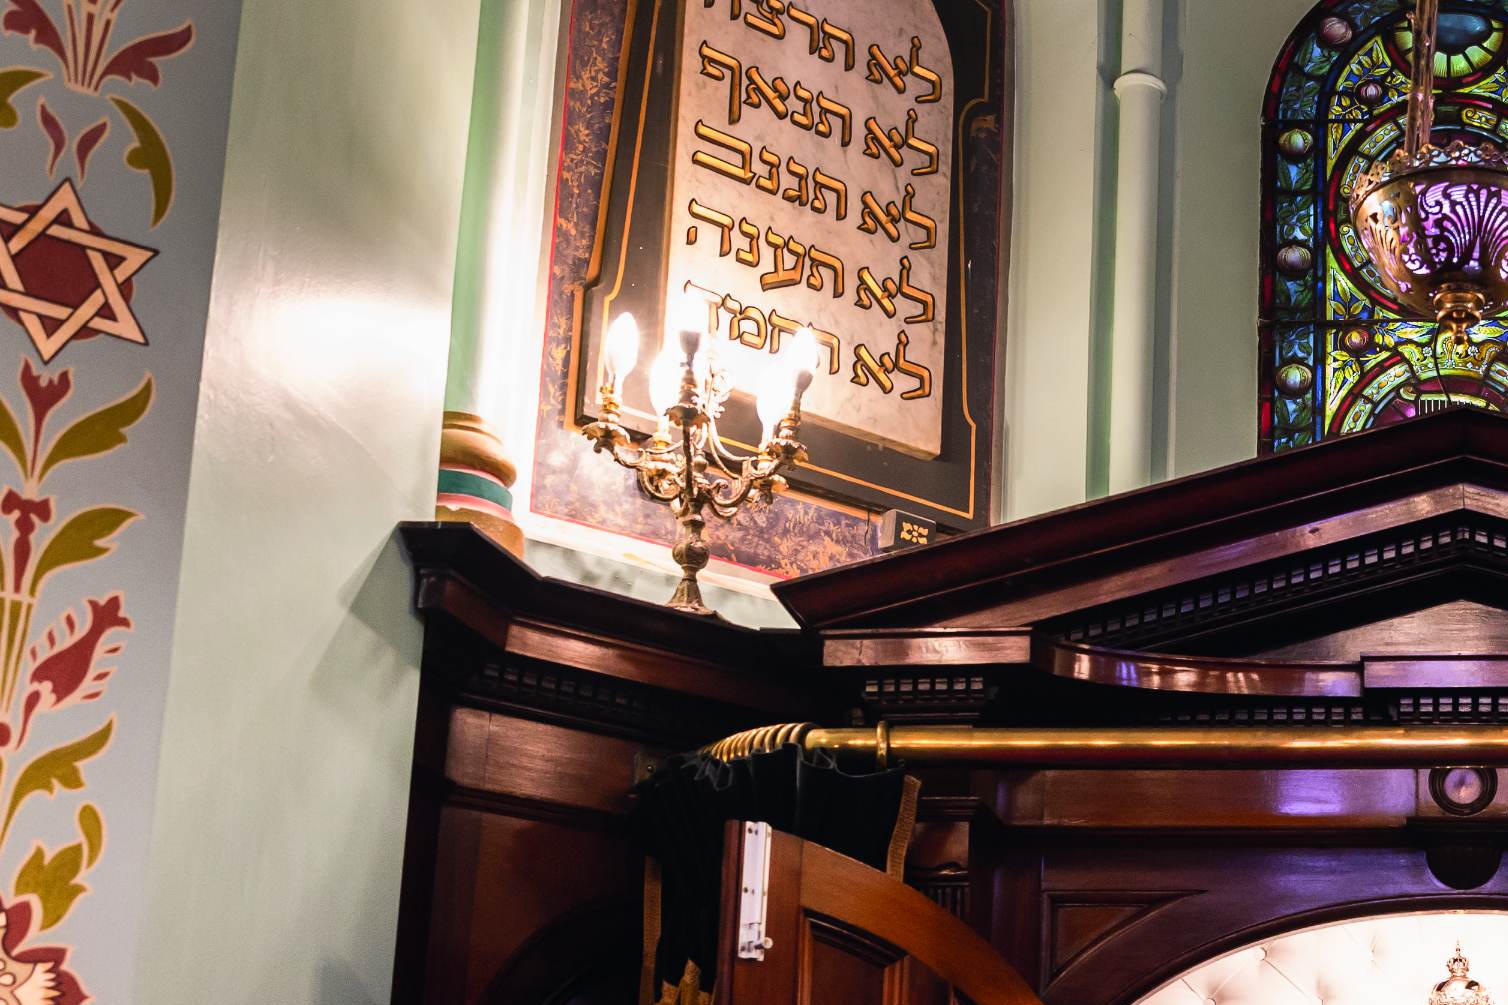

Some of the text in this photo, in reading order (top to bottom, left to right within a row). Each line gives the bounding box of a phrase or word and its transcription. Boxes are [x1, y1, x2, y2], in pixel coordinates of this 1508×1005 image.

[699, 40, 939, 176] לא תנאף
[865, 36, 942, 103] לא
[692, 119, 937, 249] לא תגנב
[686, 198, 936, 324] לא תענה
[851, 329, 932, 400] לא
